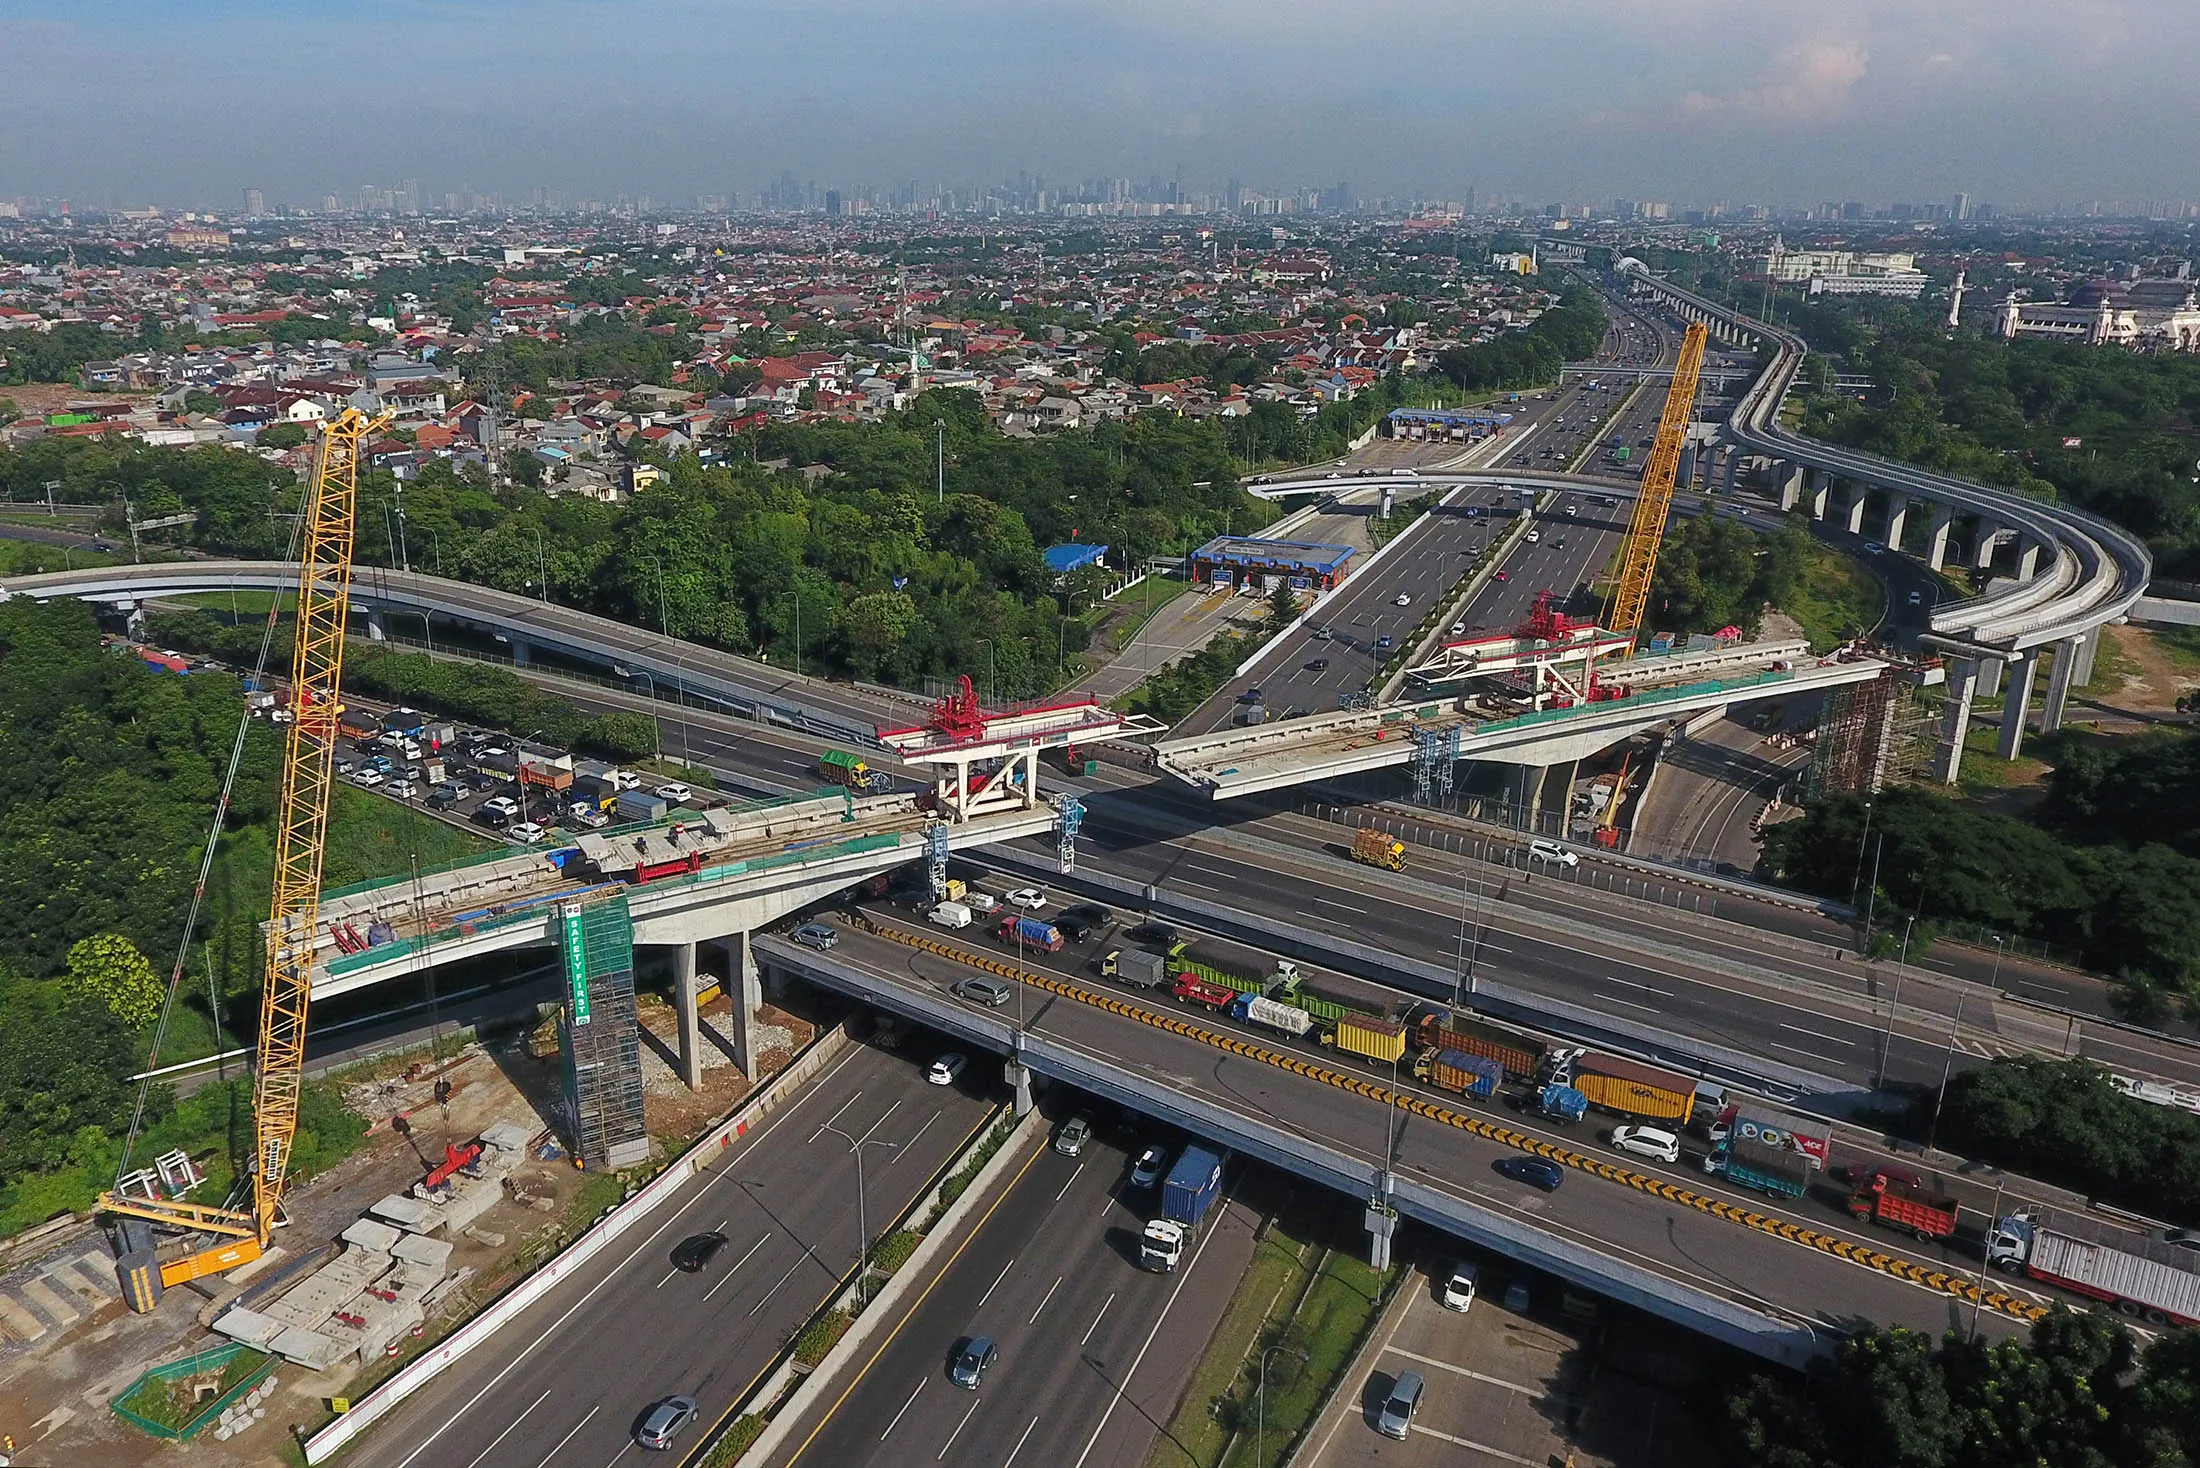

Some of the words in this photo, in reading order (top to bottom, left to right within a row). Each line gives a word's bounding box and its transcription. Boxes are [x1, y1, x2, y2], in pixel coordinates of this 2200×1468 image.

[570, 920, 582, 970] SAFETY
[575, 973, 585, 1013] FIRST
[1803, 1140, 1823, 1150] ACE
